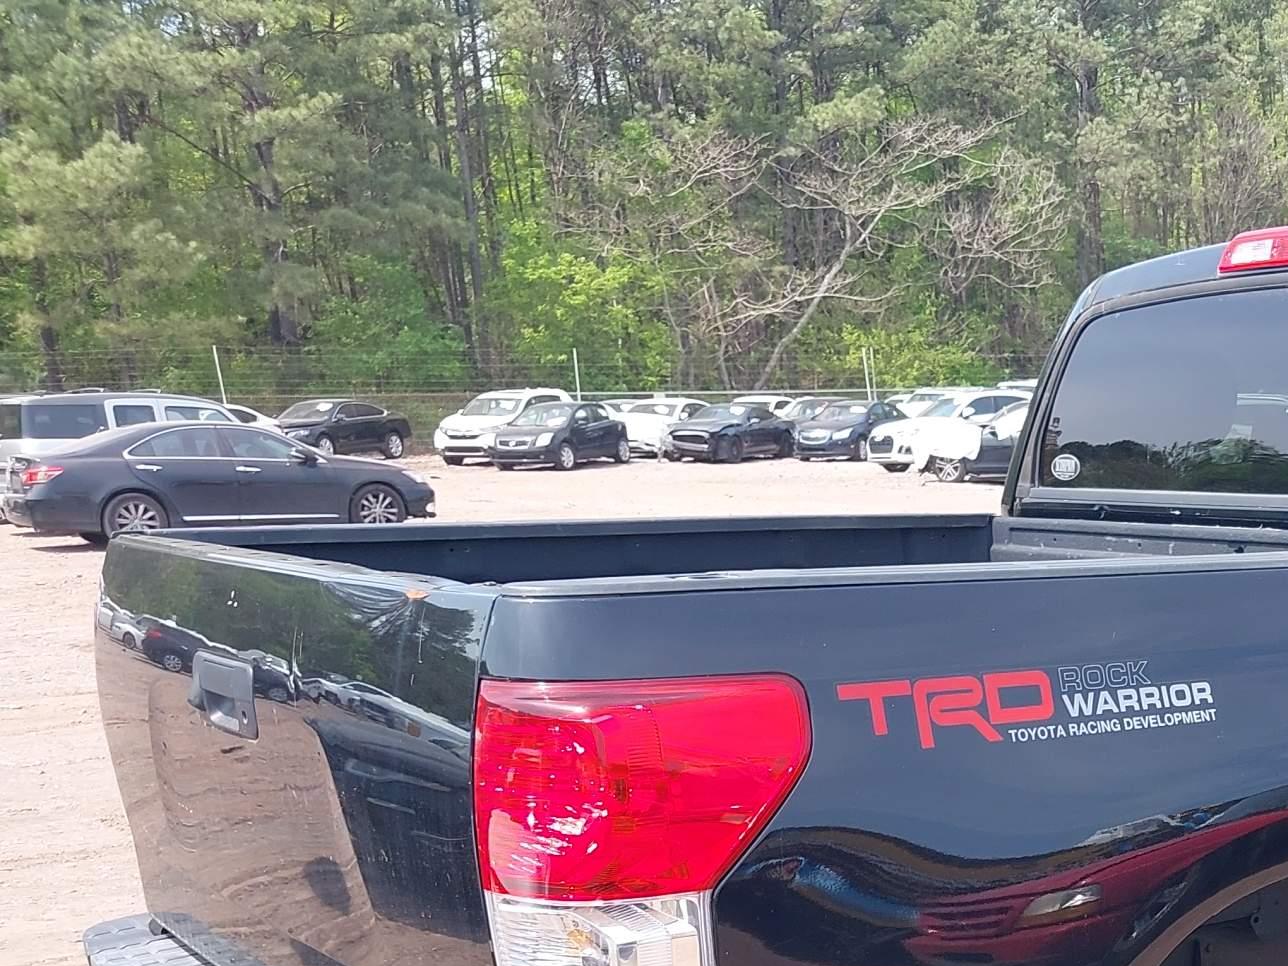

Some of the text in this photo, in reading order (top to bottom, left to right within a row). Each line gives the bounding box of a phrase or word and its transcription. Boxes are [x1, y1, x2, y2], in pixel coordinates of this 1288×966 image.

[1058, 661, 1151, 691] ROCK
[837, 670, 1054, 748] TRD
[1062, 682, 1214, 717] WARRIOR
[1008, 708, 1216, 742] TOYOTA RACING DEVELOPMENT
